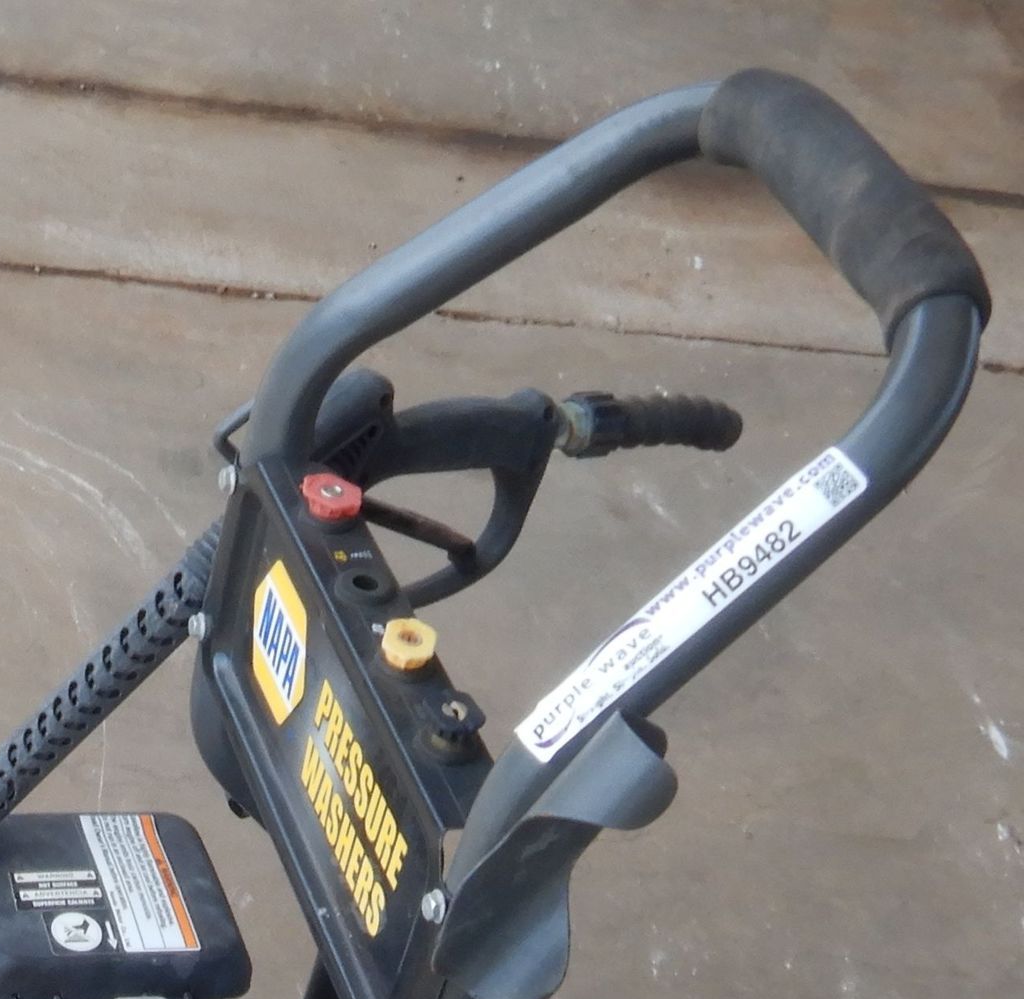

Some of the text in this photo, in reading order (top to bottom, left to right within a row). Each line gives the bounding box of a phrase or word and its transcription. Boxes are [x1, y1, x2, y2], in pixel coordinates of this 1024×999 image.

[645, 454, 835, 616] www.purplewave.com
[702, 519, 802, 607] HB9482
[258, 586, 302, 700] NAPA
[533, 677, 593, 740] purple
[598, 628, 652, 674] wave
[301, 735, 386, 938] WASHERS
[314, 678, 409, 892] PRESSURE
